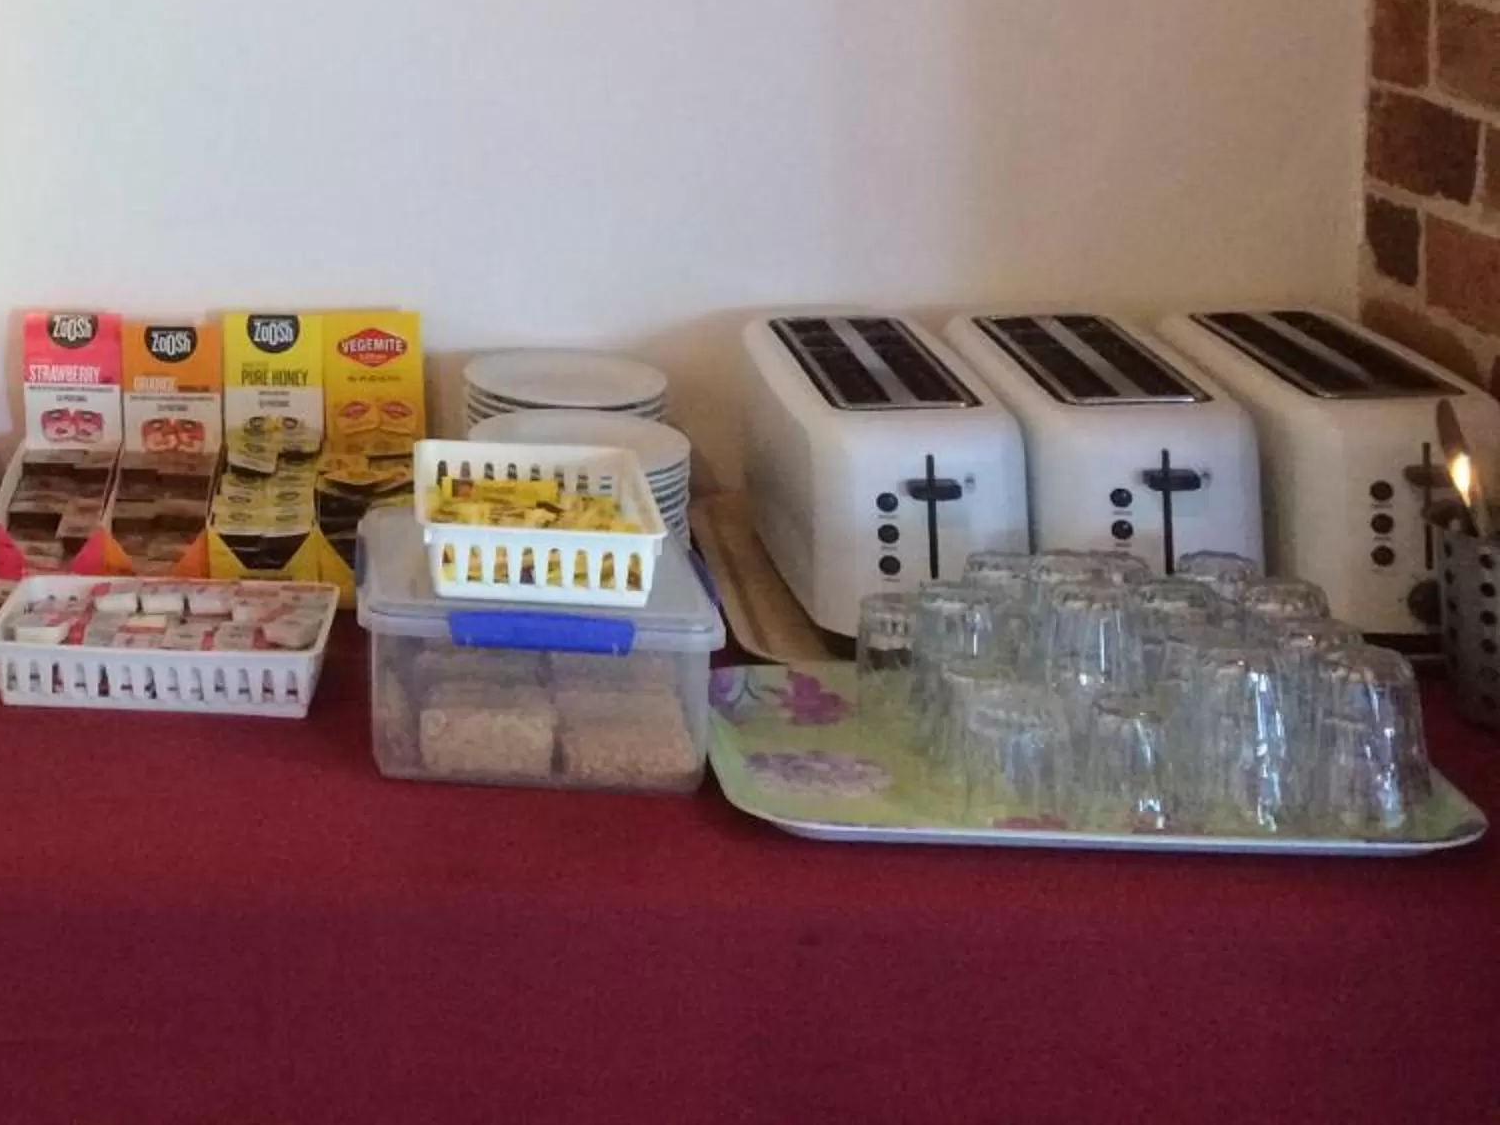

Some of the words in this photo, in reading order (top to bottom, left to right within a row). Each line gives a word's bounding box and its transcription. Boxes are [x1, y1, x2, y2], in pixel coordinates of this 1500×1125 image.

[341, 338, 403, 354] VEGEMITE
[29, 364, 101, 383] STRAWBERRY
[241, 369, 268, 387] PURE
[271, 368, 309, 387] HONEY
